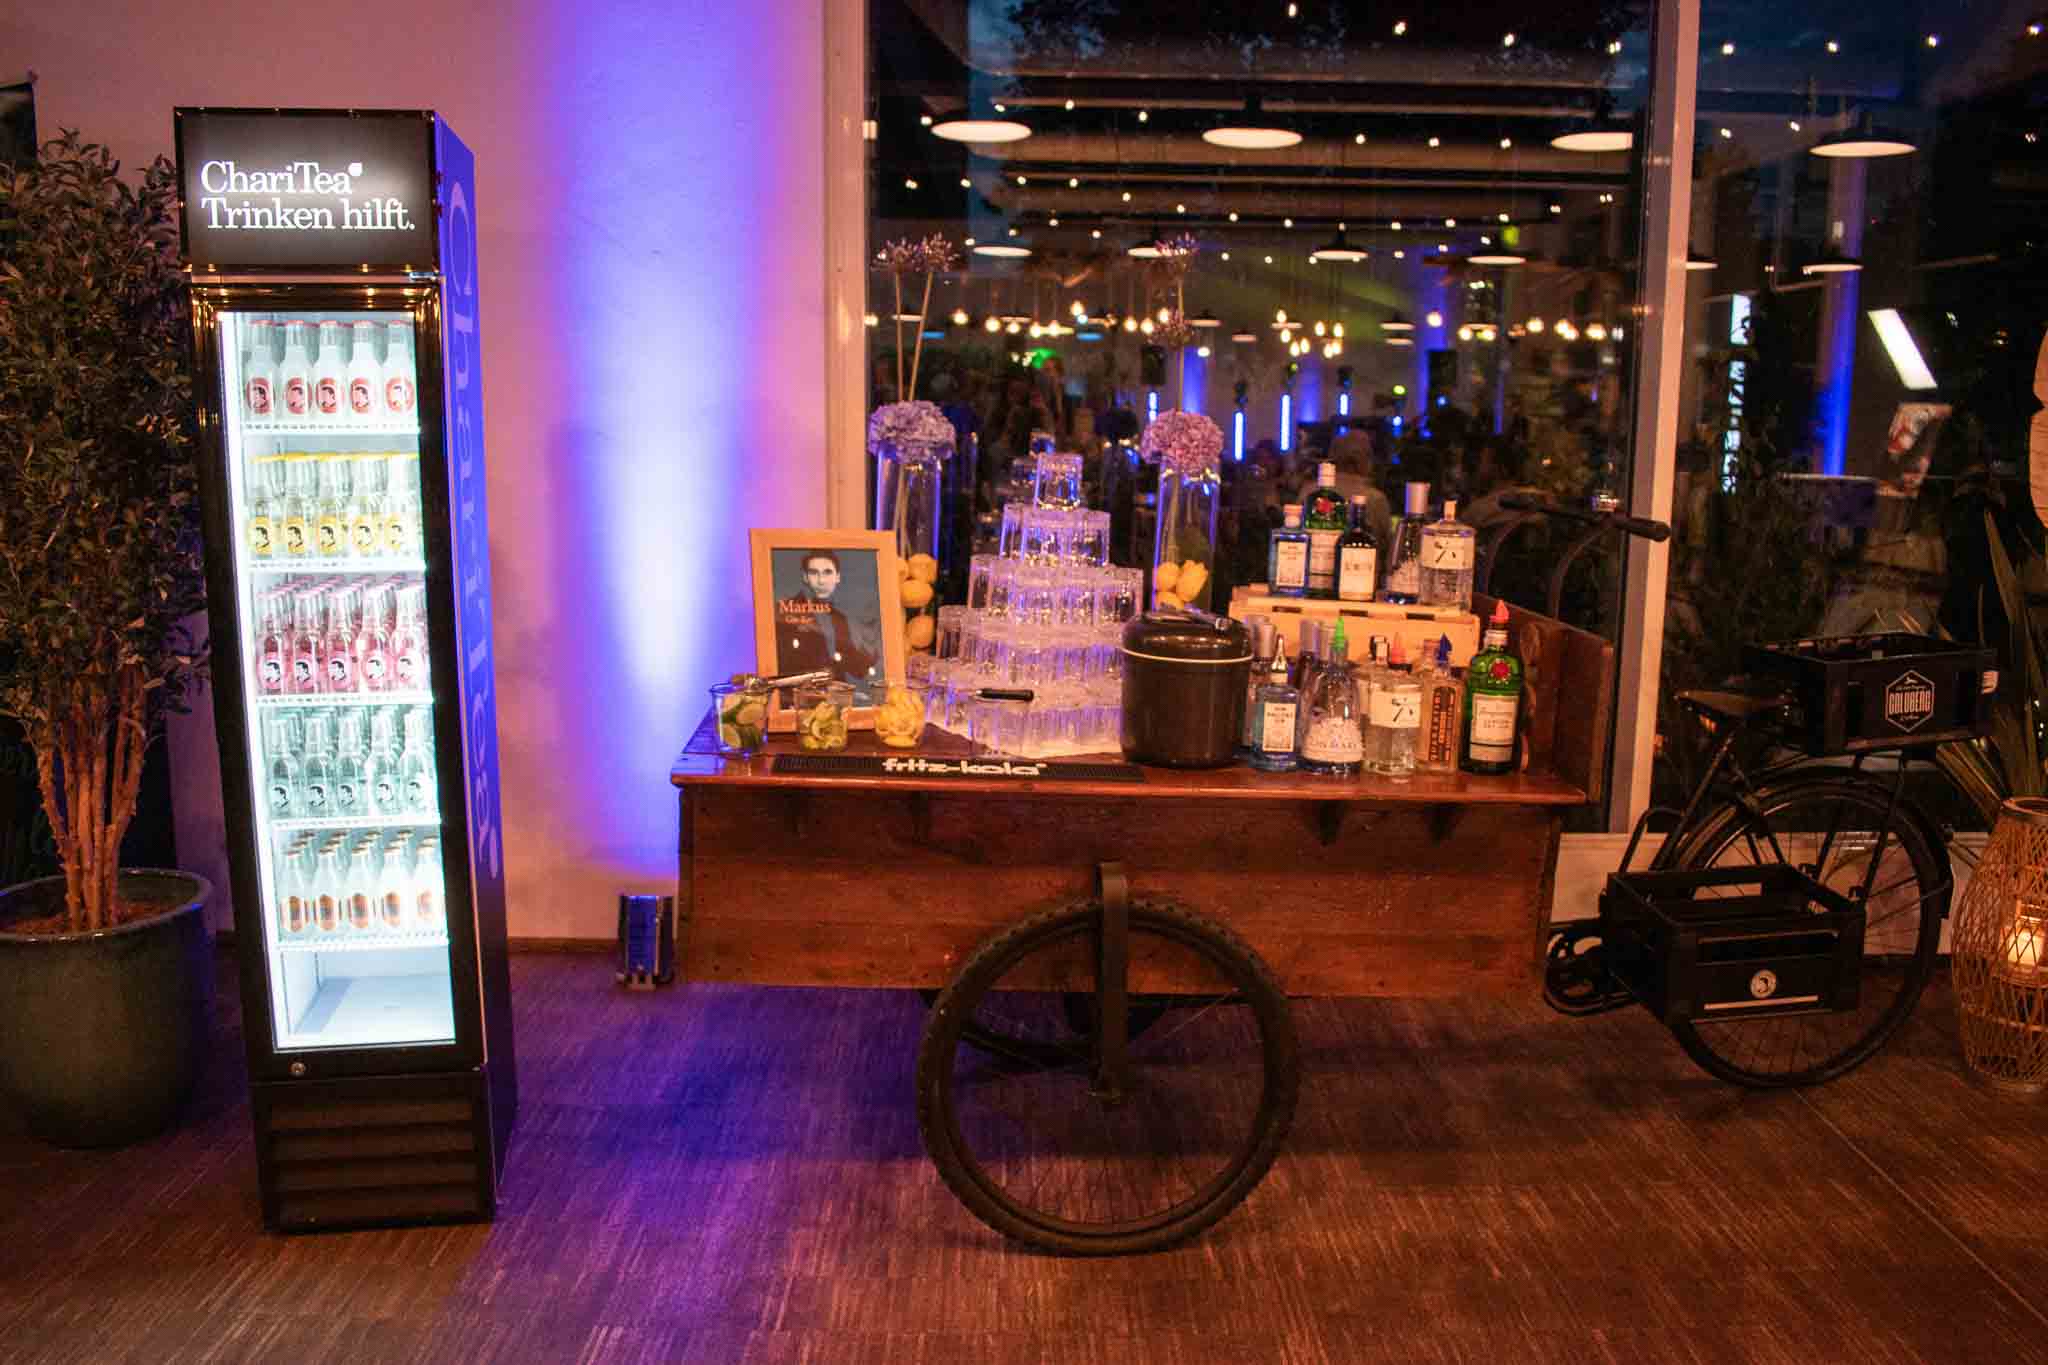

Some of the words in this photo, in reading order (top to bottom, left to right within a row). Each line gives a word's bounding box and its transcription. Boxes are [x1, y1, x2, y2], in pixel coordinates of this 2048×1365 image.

[201, 161, 352, 194] ChariTea
[201, 198, 335, 230] Trinken
[341, 198, 416, 230] hilft.
[449, 181, 490, 864] ChariTea
[778, 599, 832, 614] Markus
[1888, 689, 1931, 715] GOLDBERG
[882, 757, 1041, 776] fritz-kola
